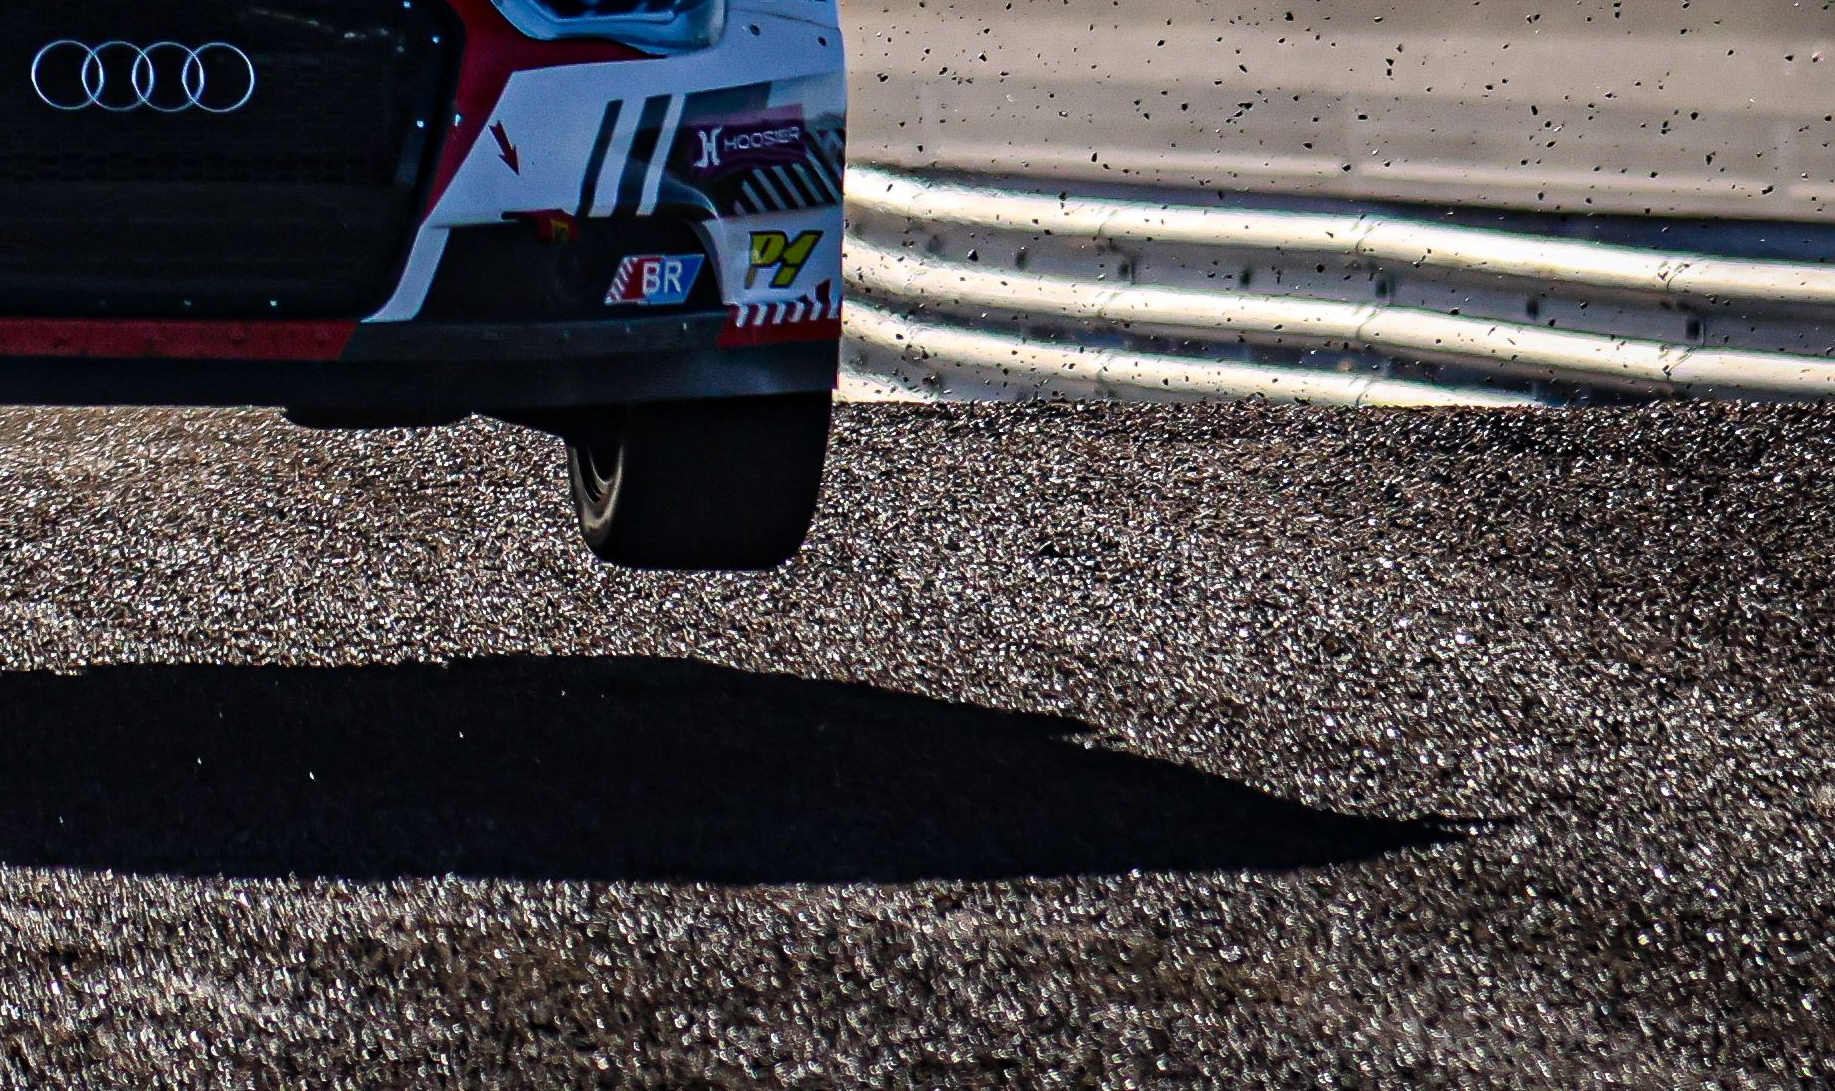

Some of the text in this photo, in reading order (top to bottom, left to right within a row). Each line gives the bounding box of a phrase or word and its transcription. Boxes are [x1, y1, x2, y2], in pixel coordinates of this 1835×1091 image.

[724, 126, 799, 151] HOOSIER
[745, 229, 825, 290] P1
[642, 260, 683, 295] BR
